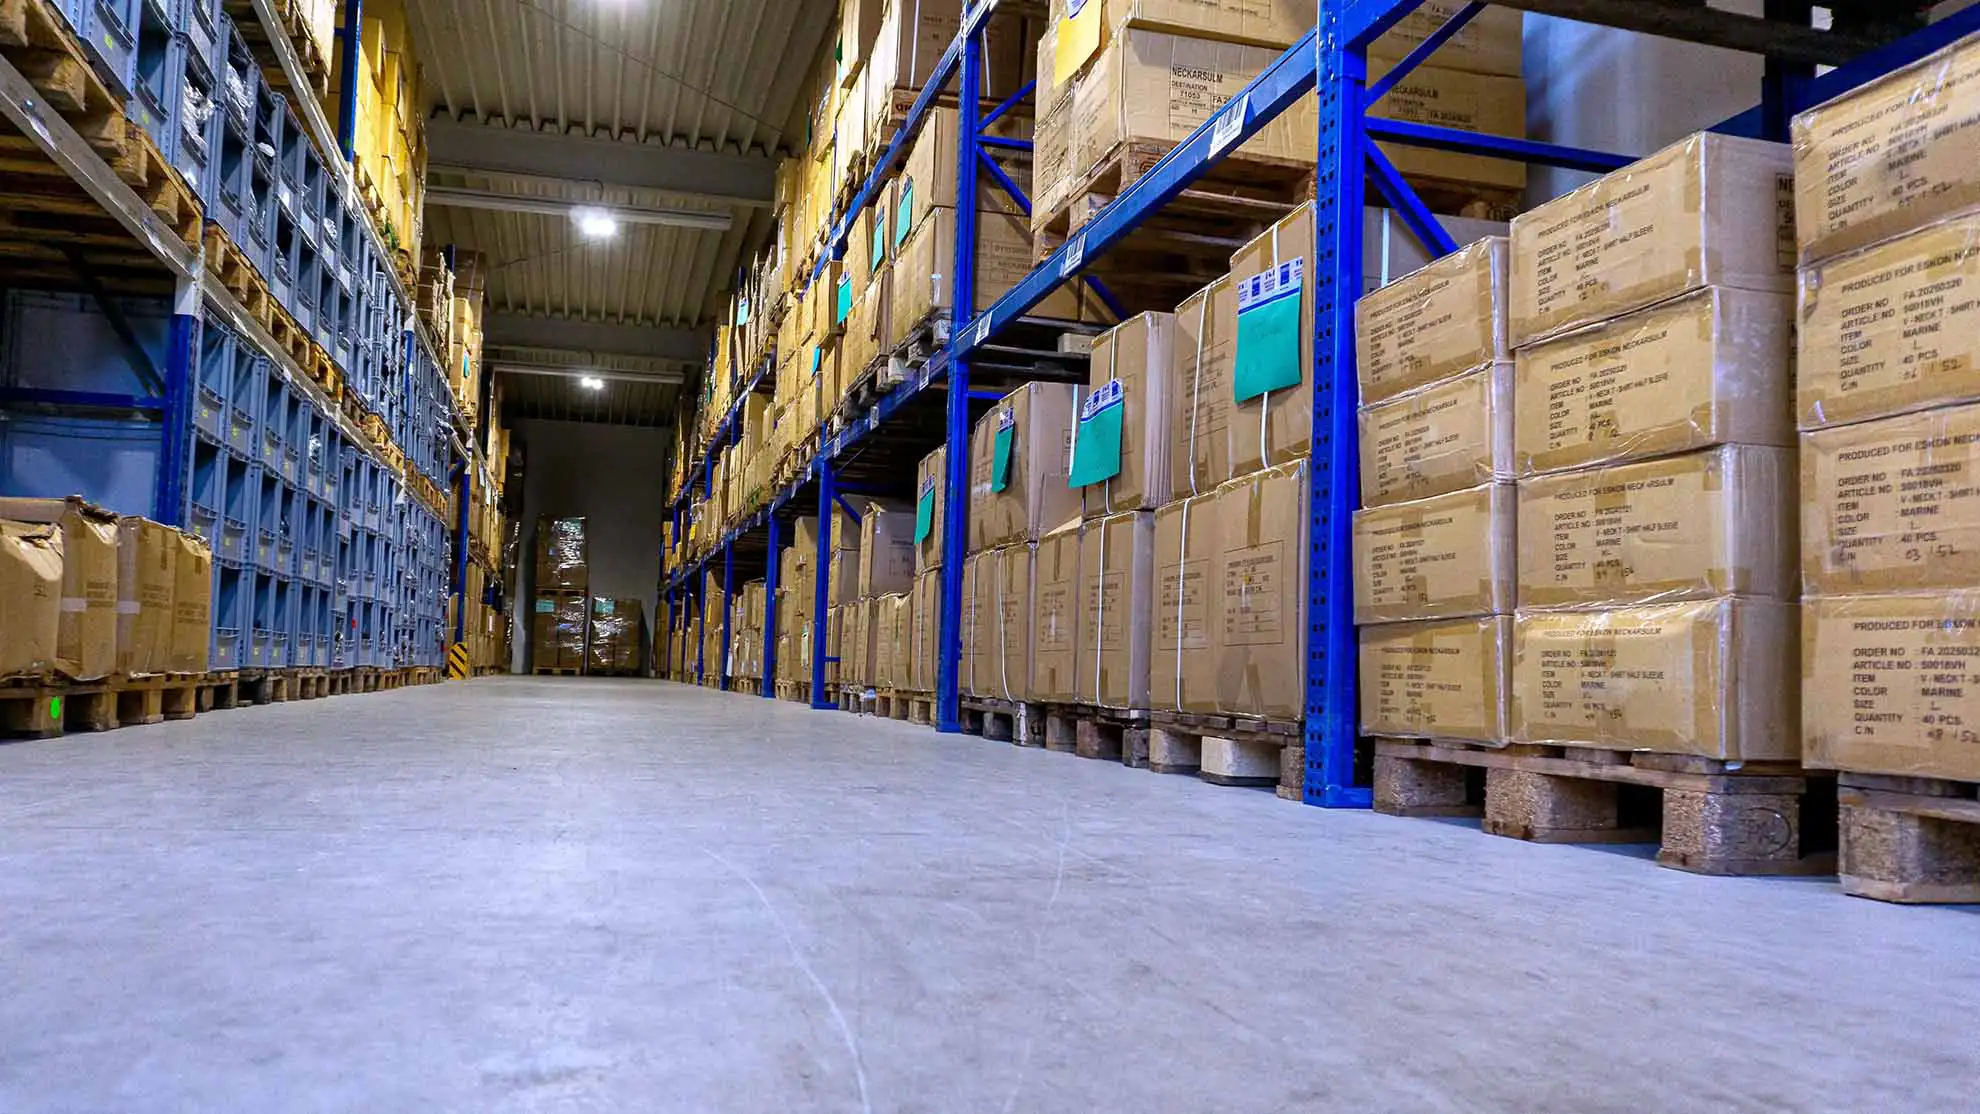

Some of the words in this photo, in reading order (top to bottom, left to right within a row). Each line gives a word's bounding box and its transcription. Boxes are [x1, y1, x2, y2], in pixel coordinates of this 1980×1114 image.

[1172, 67, 1222, 83] NECKARSULM
[1828, 196, 1875, 219] QUANTITY
[1841, 271, 1892, 293] PRODUCED
[1895, 265, 1914, 278] FOR
[1841, 304, 1872, 318] ORDER
[1875, 298, 1889, 310] NO
[1840, 315, 1877, 330] ARTICLE
[1882, 309, 1895, 320] NO
[1840, 330, 1862, 342] ITEM
[1840, 339, 1872, 354] COLOR
[1903, 322, 1941, 339] MARINE
[1551, 357, 1583, 371] PRODUCED
[1840, 355, 1860, 367] SIZE
[1840, 361, 1886, 380] QUANTITY
[1918, 350, 1938, 361] PCS
[1550, 381, 1571, 391] ORDER
[1550, 389, 1574, 400] ARTICLE
[1576, 385, 1585, 393] NO
[1550, 401, 1564, 410] ITEM
[1550, 409, 1570, 420] COLOR
[1589, 398, 1613, 410] MARINE
[1550, 427, 1578, 439] QUANTITY
[1838, 448, 1889, 462] PRODUCED
[1892, 442, 1912, 453] FOR
[1838, 474, 1870, 487] ORDER
[1872, 472, 1886, 482] NO
[1901, 468, 1913, 478] FA
[1554, 490, 1588, 500] PRODUCED
[1838, 486, 1875, 499] ARTICLE
[1878, 484, 1892, 494] NO
[1838, 501, 1859, 512] ITEM
[1554, 512, 1575, 521] ORDER
[1838, 512, 1869, 524] COLOR
[1901, 505, 1939, 517] MARINE
[1554, 523, 1579, 531] ARTICLE
[1838, 526, 1857, 536] SIZE
[1555, 542, 1576, 551] COLOR
[1596, 538, 1621, 547] MARINE
[1838, 537, 1884, 550] QUANTITY
[1901, 534, 1914, 543] 40
[1916, 531, 1937, 542] PCS
[1555, 562, 1586, 571] QUANTITY
[1854, 621, 1909, 631] PRODUCED
[1912, 620, 1934, 629] FOR
[1853, 648, 1888, 657] ORDER
[1890, 647, 1905, 656] NO
[1921, 647, 1935, 656] FA
[1853, 660, 1895, 670] ARTICLE
[1897, 660, 1911, 669] NO
[1642, 671, 1664, 679] SLEEVE
[1853, 674, 1875, 682] ITEM
[1853, 687, 1888, 696] COLOR
[1921, 687, 1963, 698] MARINE
[1543, 701, 1572, 709] QUANTITY
[1853, 700, 1875, 709] SIZE
[1931, 701, 1941, 711] L
[1854, 713, 1904, 722] QUANTITY
[1922, 715, 1935, 725] 40
[1939, 716, 1962, 726] PCS
